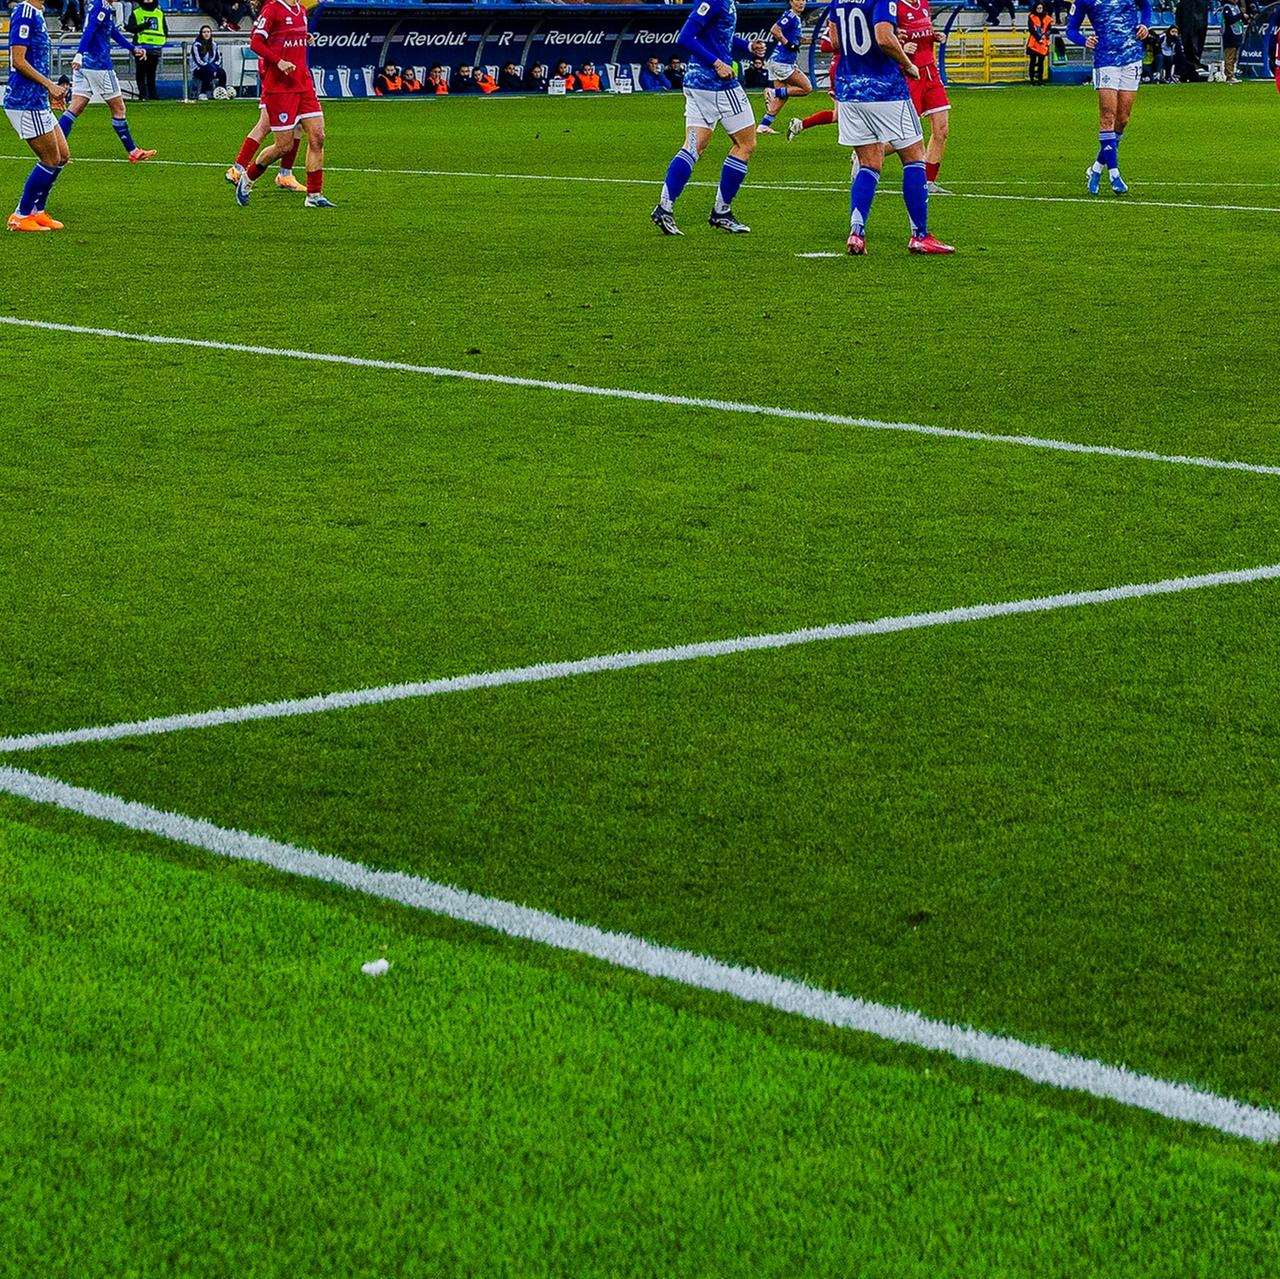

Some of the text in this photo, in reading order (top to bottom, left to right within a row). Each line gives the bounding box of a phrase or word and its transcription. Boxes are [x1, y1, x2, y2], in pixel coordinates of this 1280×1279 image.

[404, 31, 467, 46] Revolut
[498, 31, 513, 46] R
[544, 30, 605, 45] Revolut
[634, 30, 678, 44] Revol
[836, 8, 872, 56] 10
